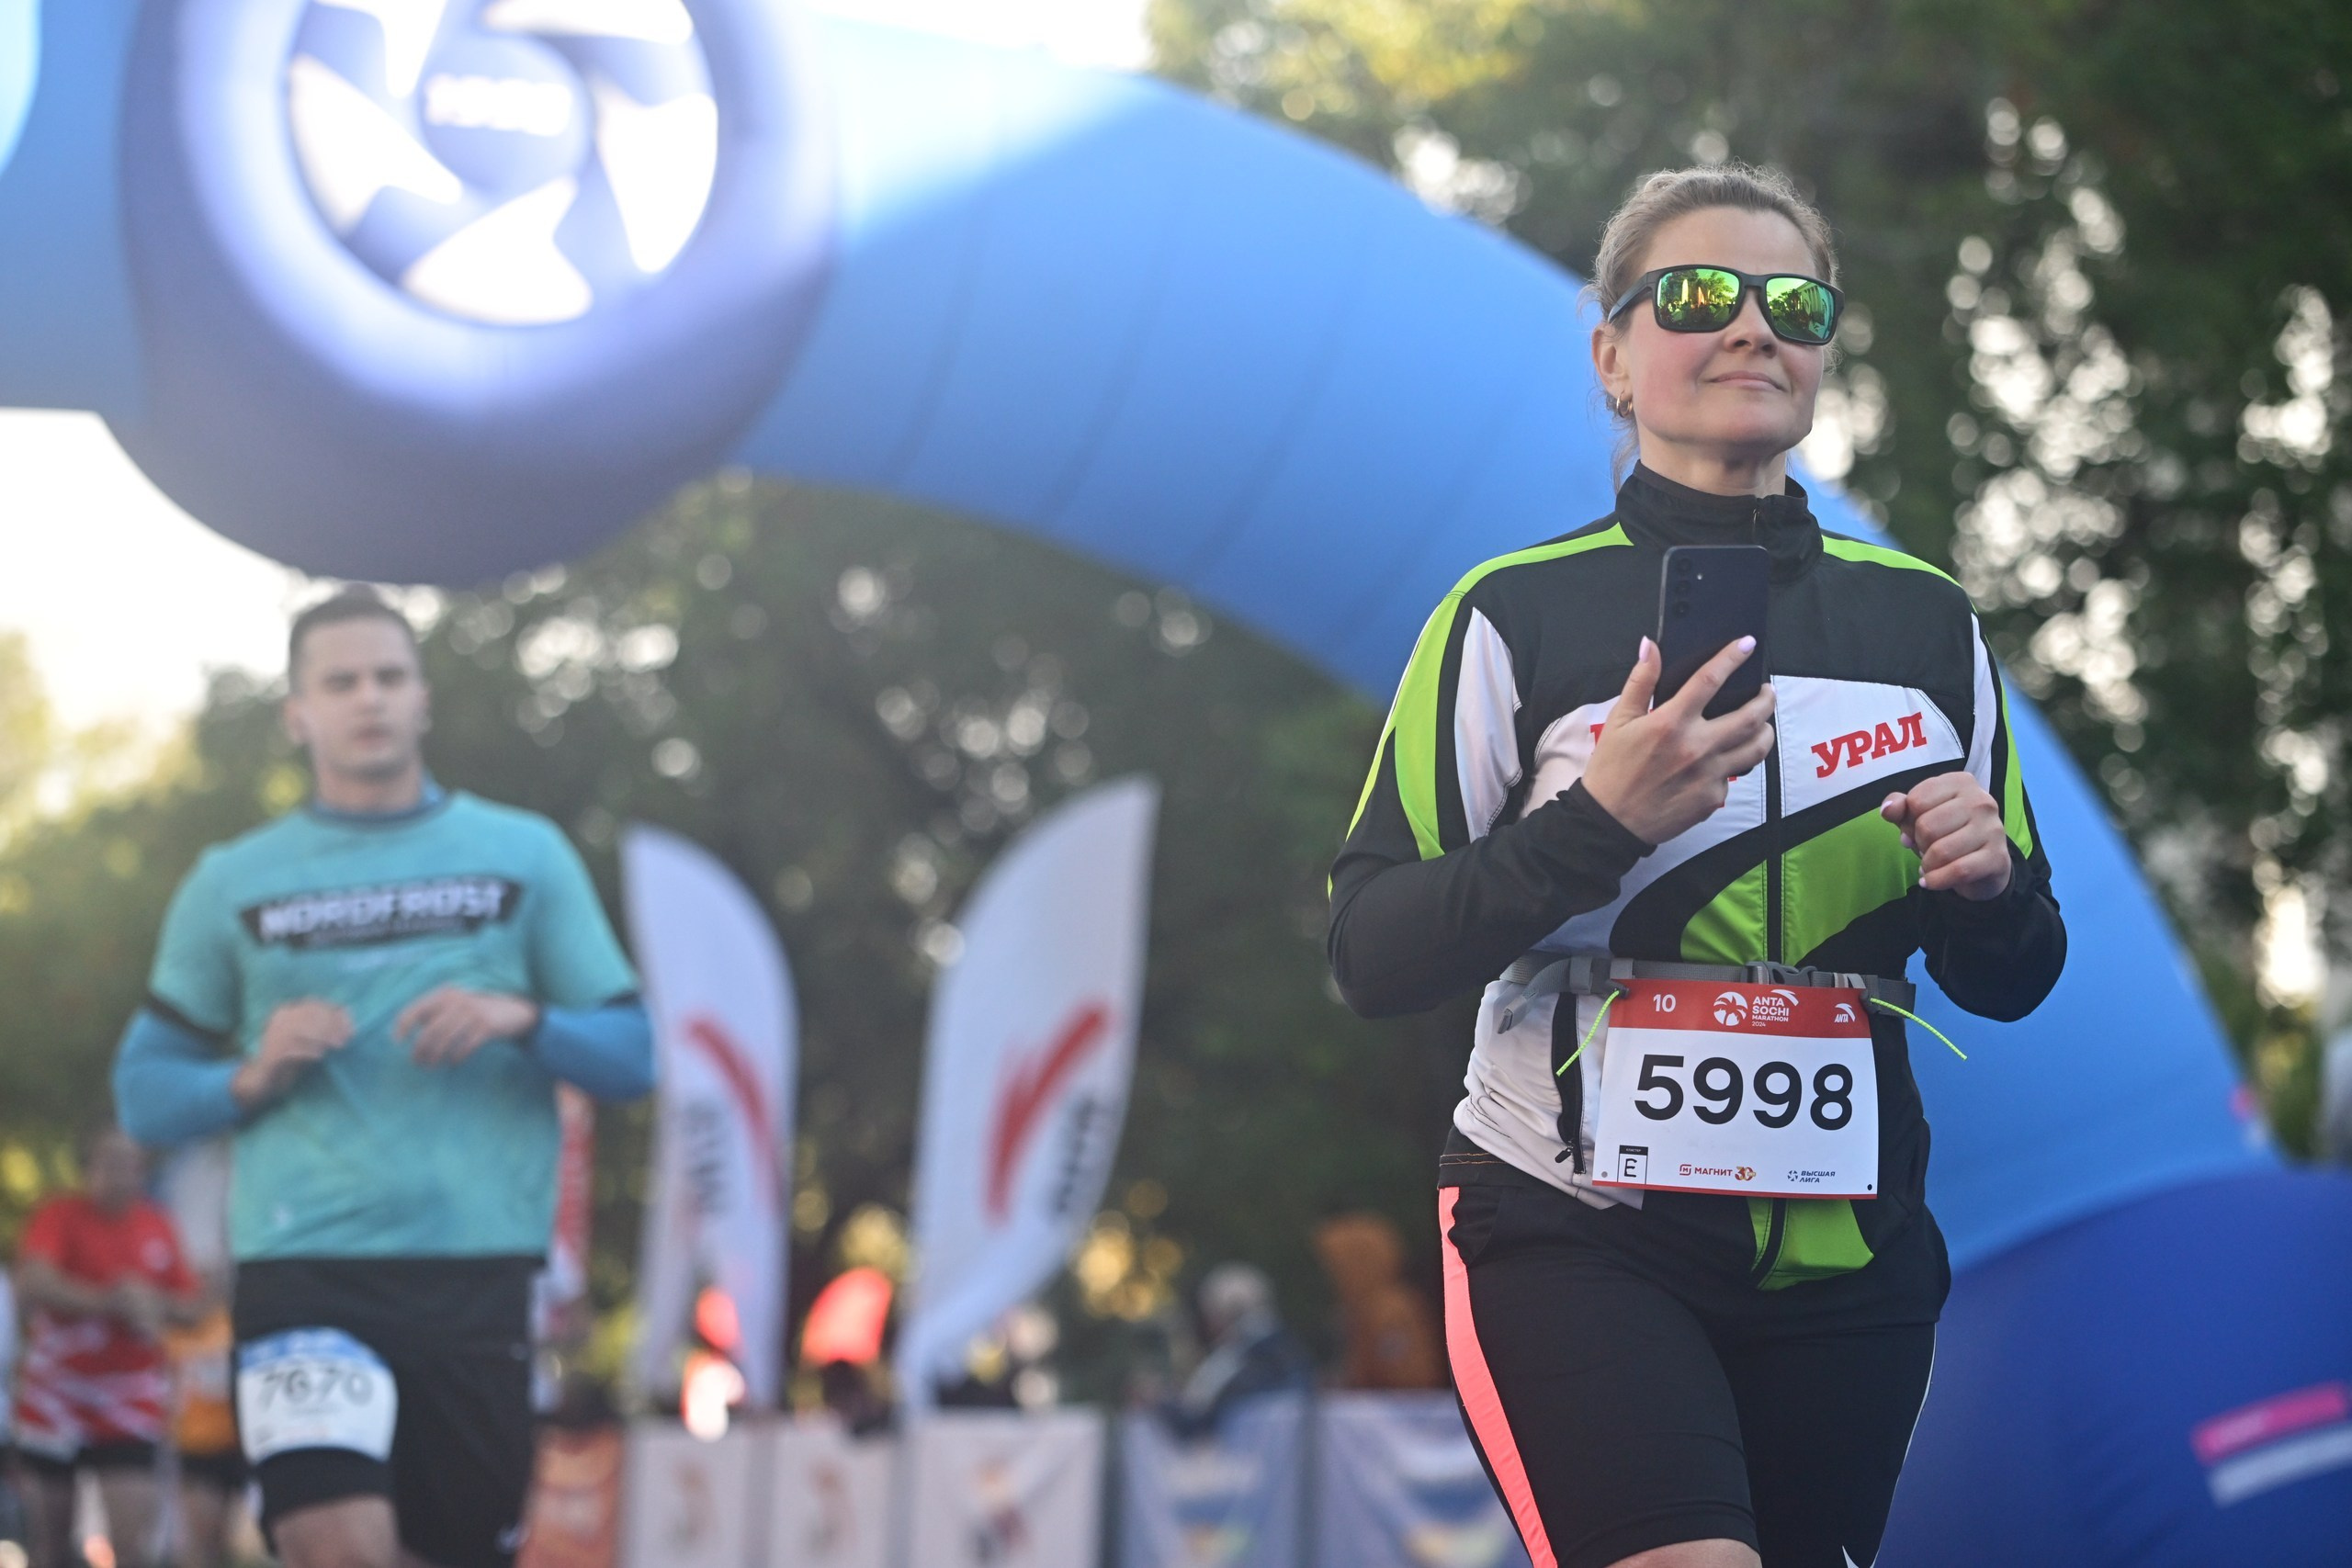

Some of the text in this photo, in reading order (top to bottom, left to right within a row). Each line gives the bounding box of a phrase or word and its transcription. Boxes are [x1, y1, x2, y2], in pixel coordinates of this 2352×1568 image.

[1811, 712, 1927, 779] УРАЛ
[1654, 994, 1676, 1012] 10
[1753, 996, 1784, 1007] ANTA
[1752, 1006, 1790, 1016] SOCHI
[1834, 1013, 1849, 1023] ANTA
[1634, 1054, 1853, 1131] 5998
[1694, 1168, 1733, 1177] МАГНИТ
